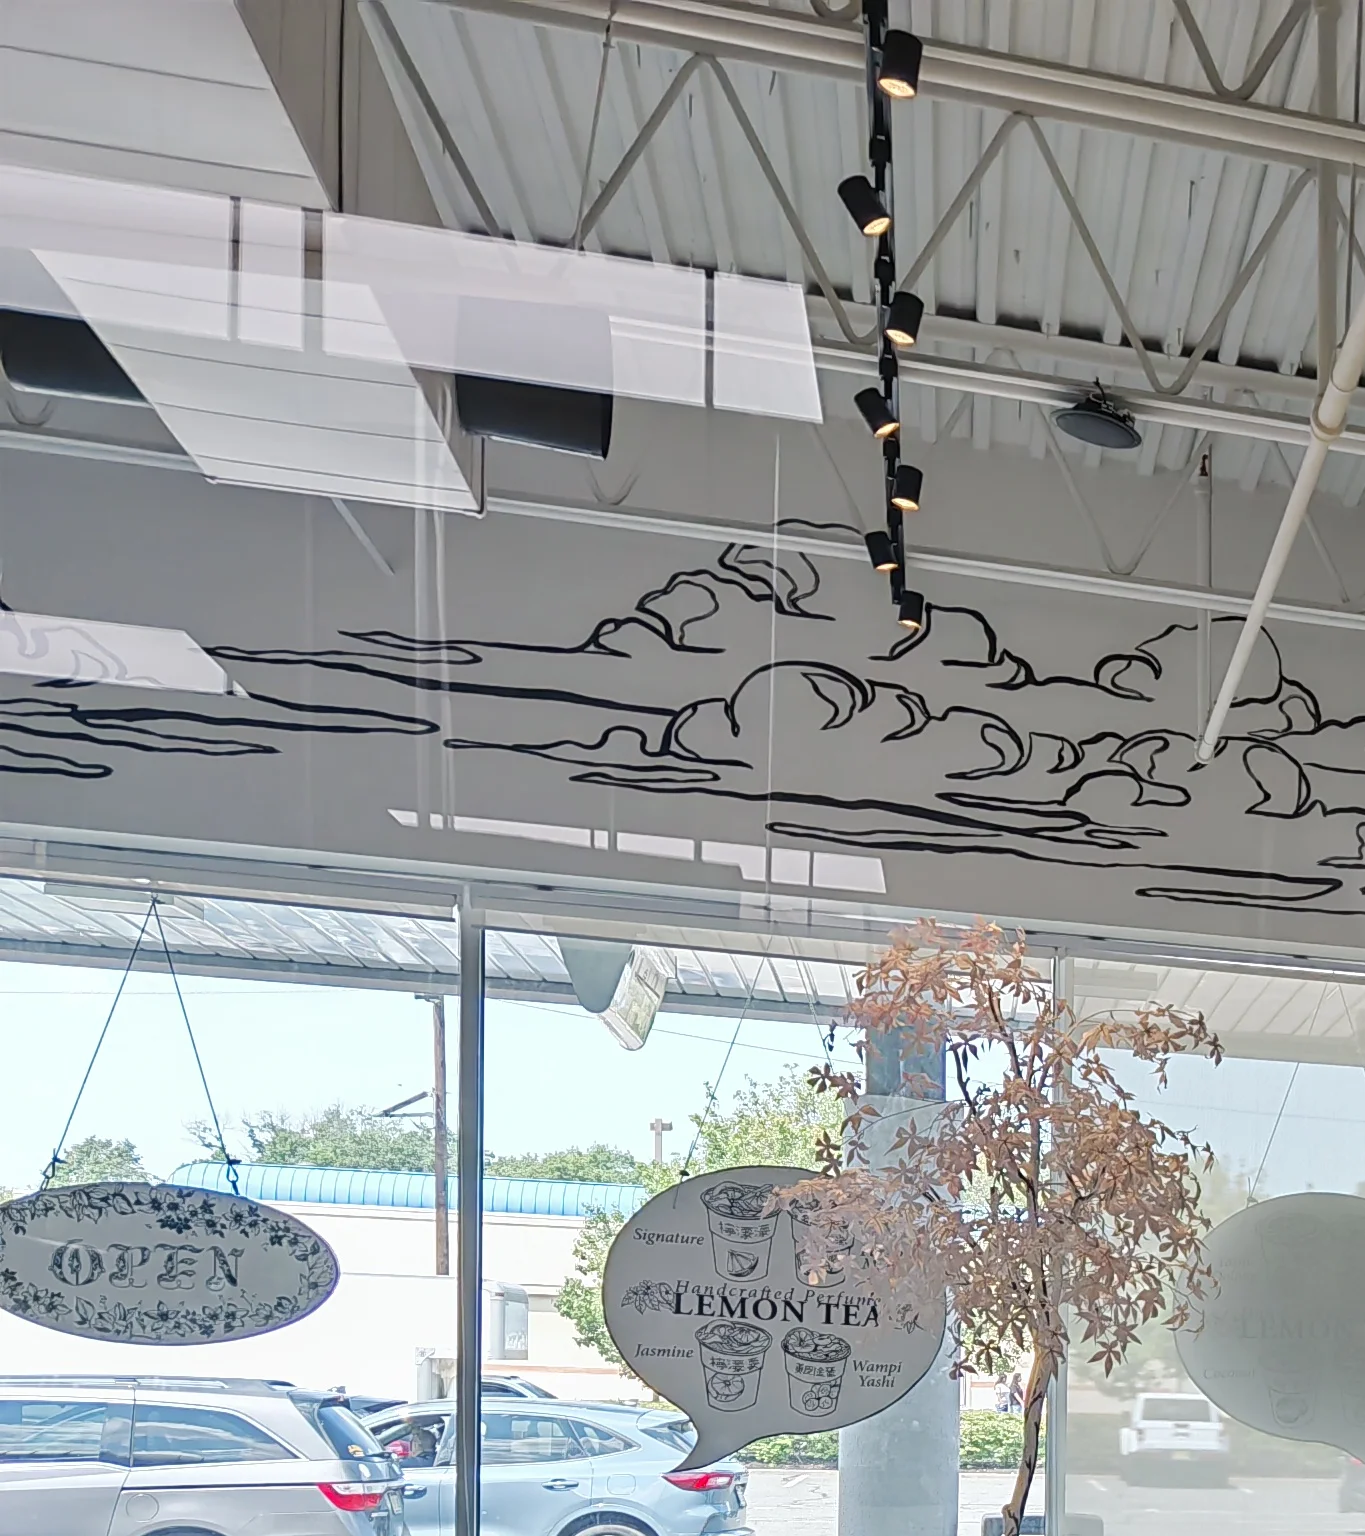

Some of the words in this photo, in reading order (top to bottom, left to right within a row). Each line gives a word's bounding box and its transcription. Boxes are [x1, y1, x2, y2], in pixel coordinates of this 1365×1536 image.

[633, 1228, 705, 1245] Signature
[48, 1239, 245, 1291] OPEN
[675, 1280, 795, 1301] Handcrafted
[672, 1292, 806, 1323] LEMON
[817, 1301, 879, 1328] TEA
[634, 1344, 694, 1358] Jasmine
[852, 1360, 902, 1376] Wampi
[859, 1375, 895, 1388] Yashi
